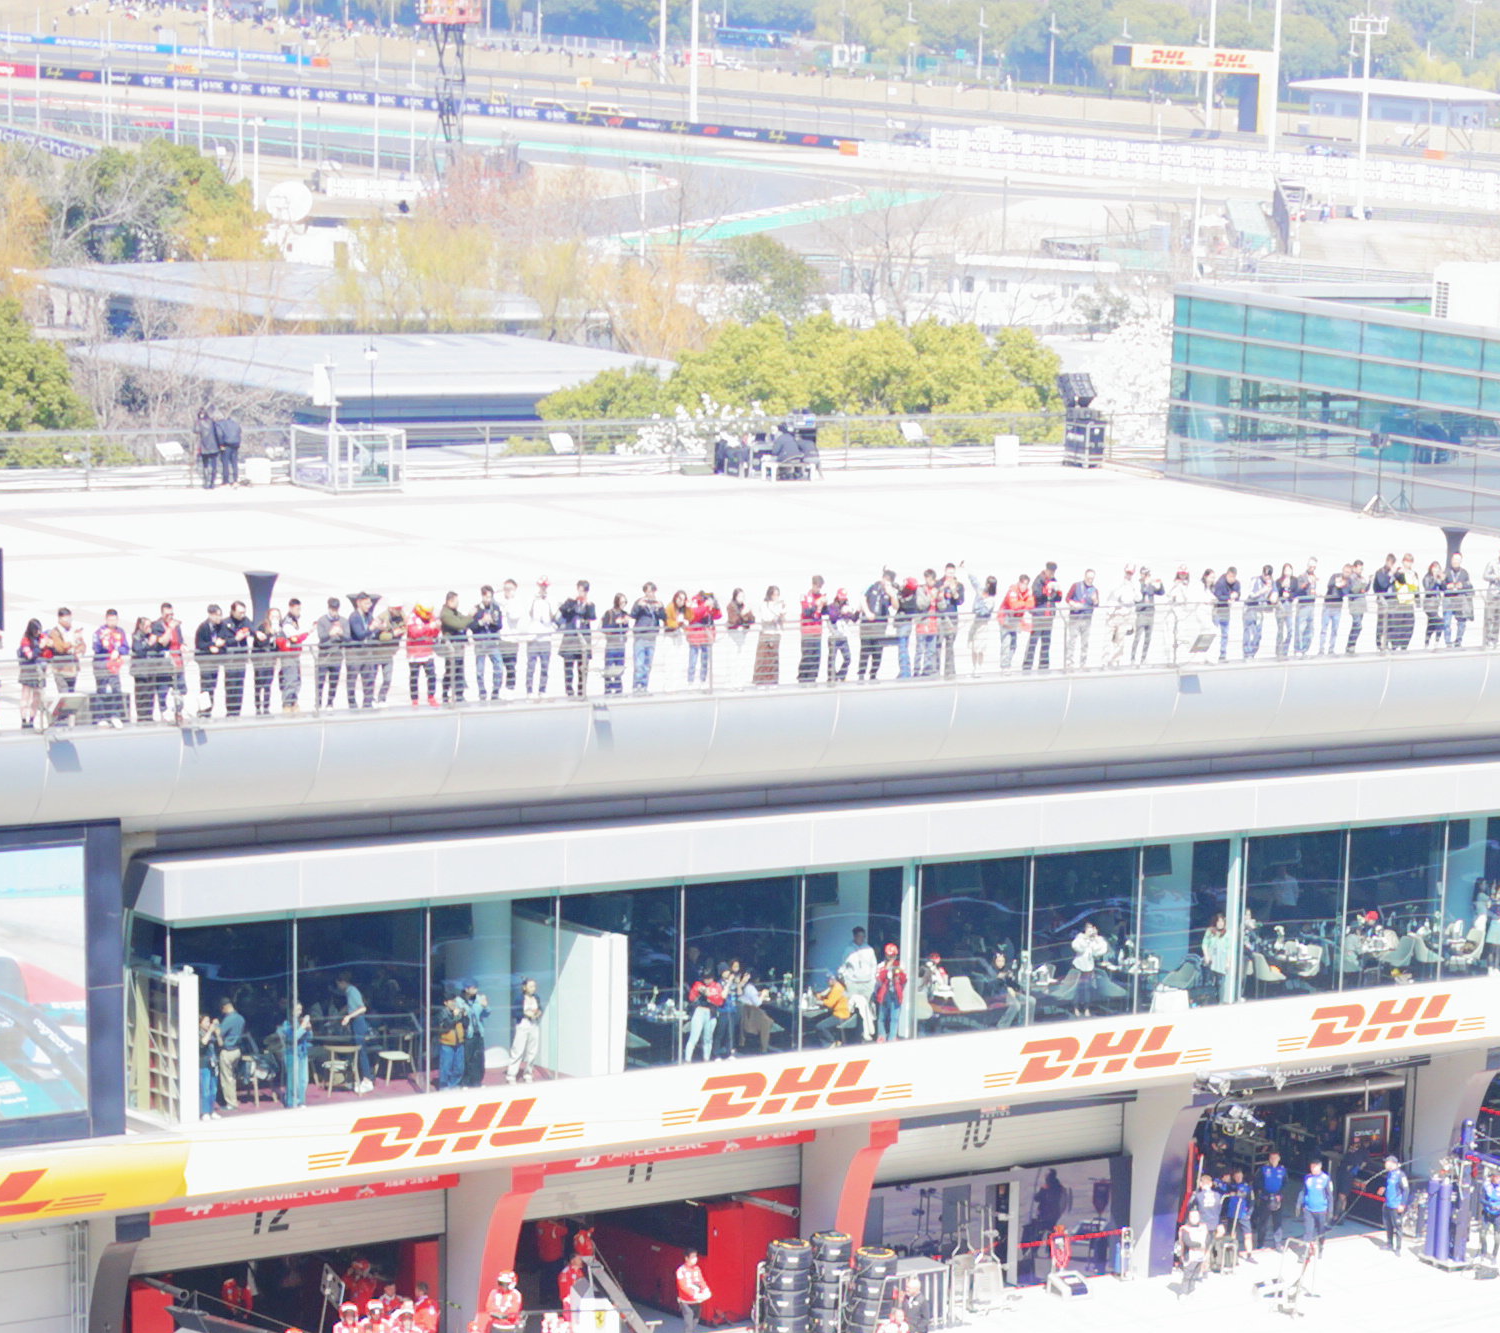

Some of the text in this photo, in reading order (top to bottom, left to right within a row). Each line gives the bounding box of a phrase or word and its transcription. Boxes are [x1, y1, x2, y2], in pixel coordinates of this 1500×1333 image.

[1151, 49, 1186, 65] DHL
[1214, 53, 1247, 68] DHL
[1306, 993, 1458, 1049] DHL
[1017, 1025, 1183, 1084] DHL
[697, 1059, 881, 1123] DHL
[347, 1098, 547, 1166] DHL
[962, 1118, 993, 1150] 10
[1354, 1128, 1381, 1137] ORACLE
[627, 1161, 654, 1184] 11
[253, 1208, 290, 1235] 12
